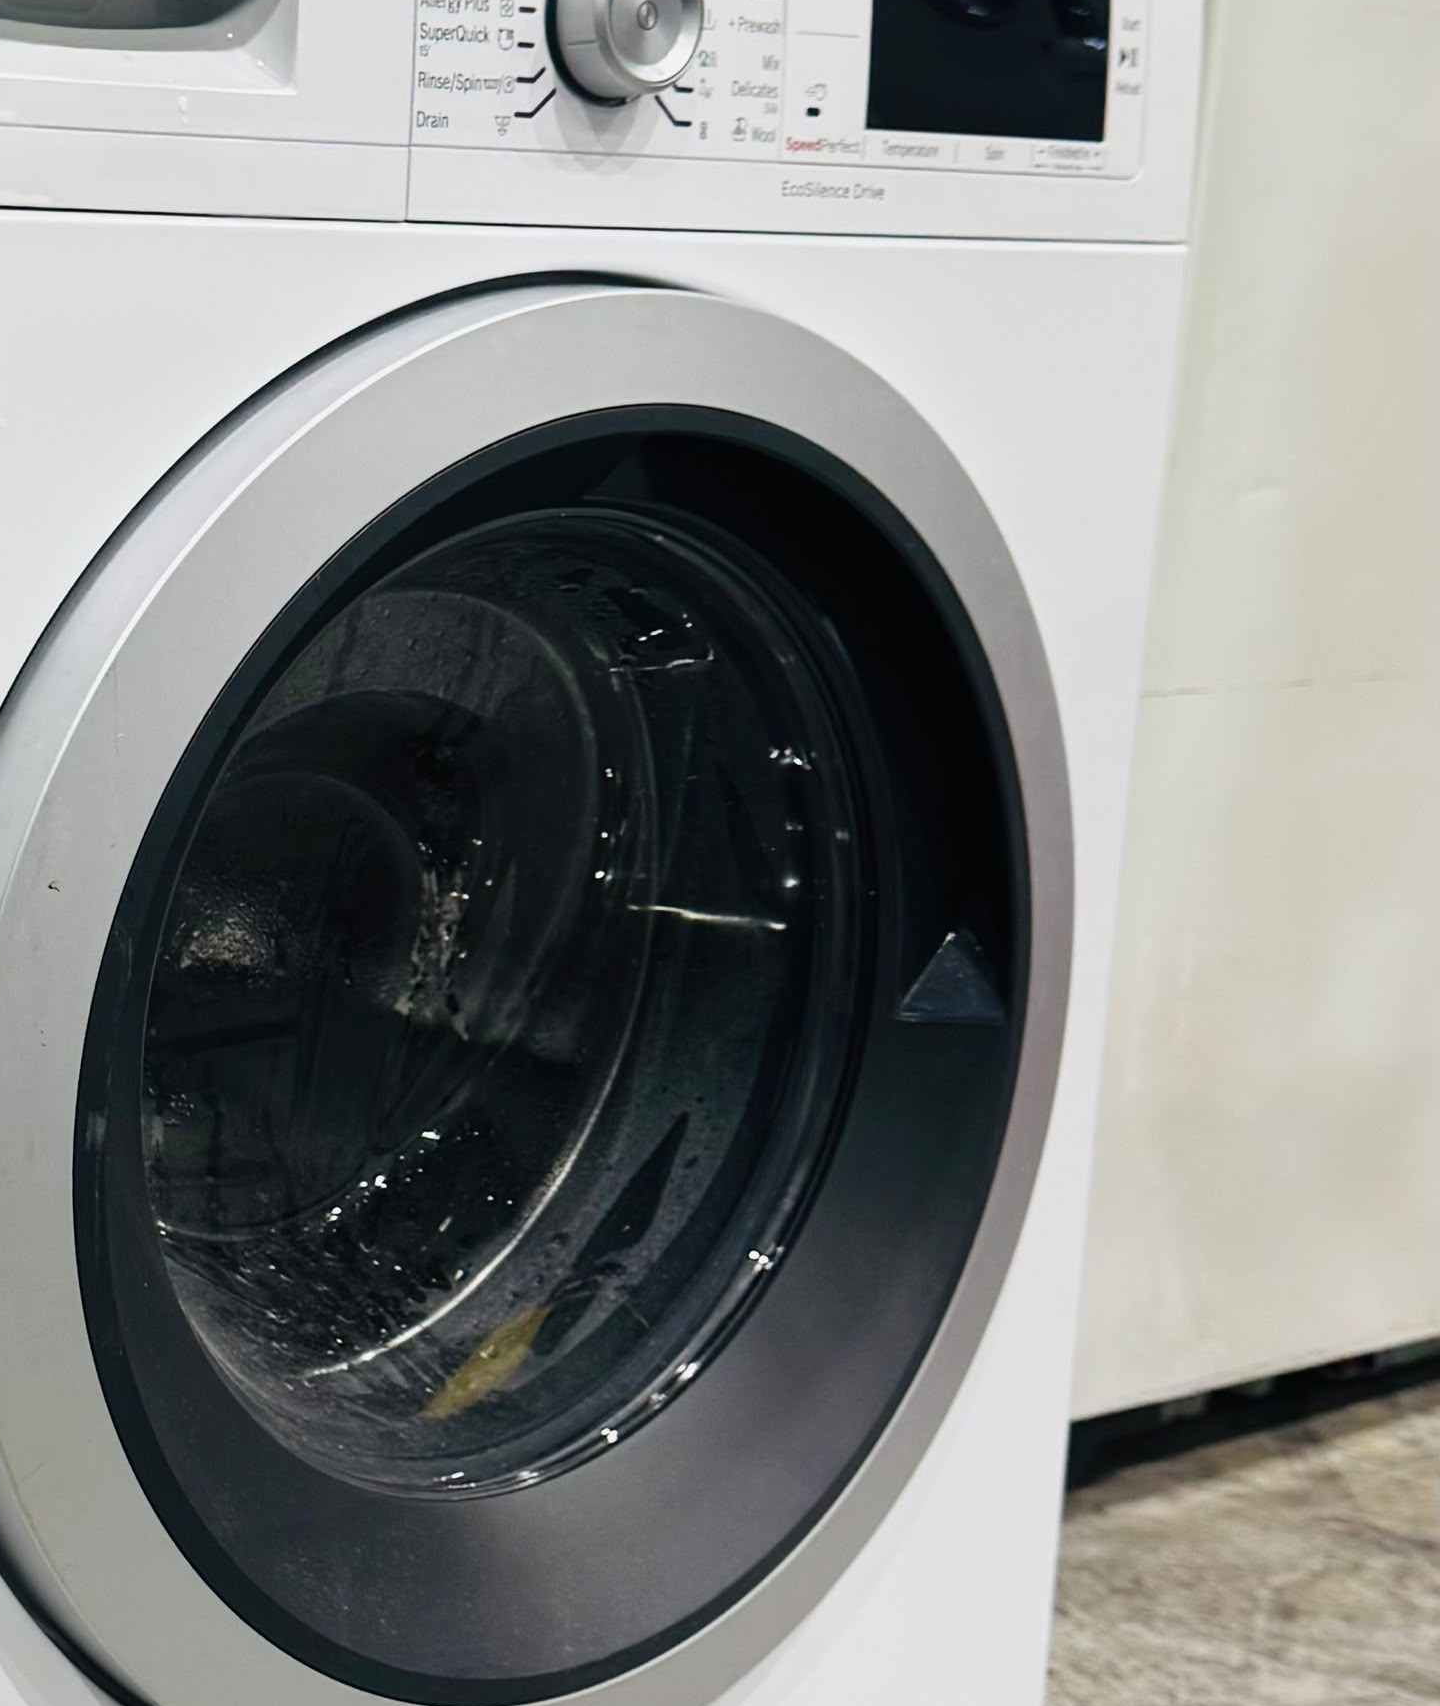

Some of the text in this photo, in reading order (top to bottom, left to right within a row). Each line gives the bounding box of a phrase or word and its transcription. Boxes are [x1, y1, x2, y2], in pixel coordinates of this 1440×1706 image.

[420, 22, 490, 44] SuperQuick
[418, 71, 482, 94] Rinse/Spin
[416, 111, 449, 129] Drain
[781, 180, 885, 201] EcoSilence Drive
